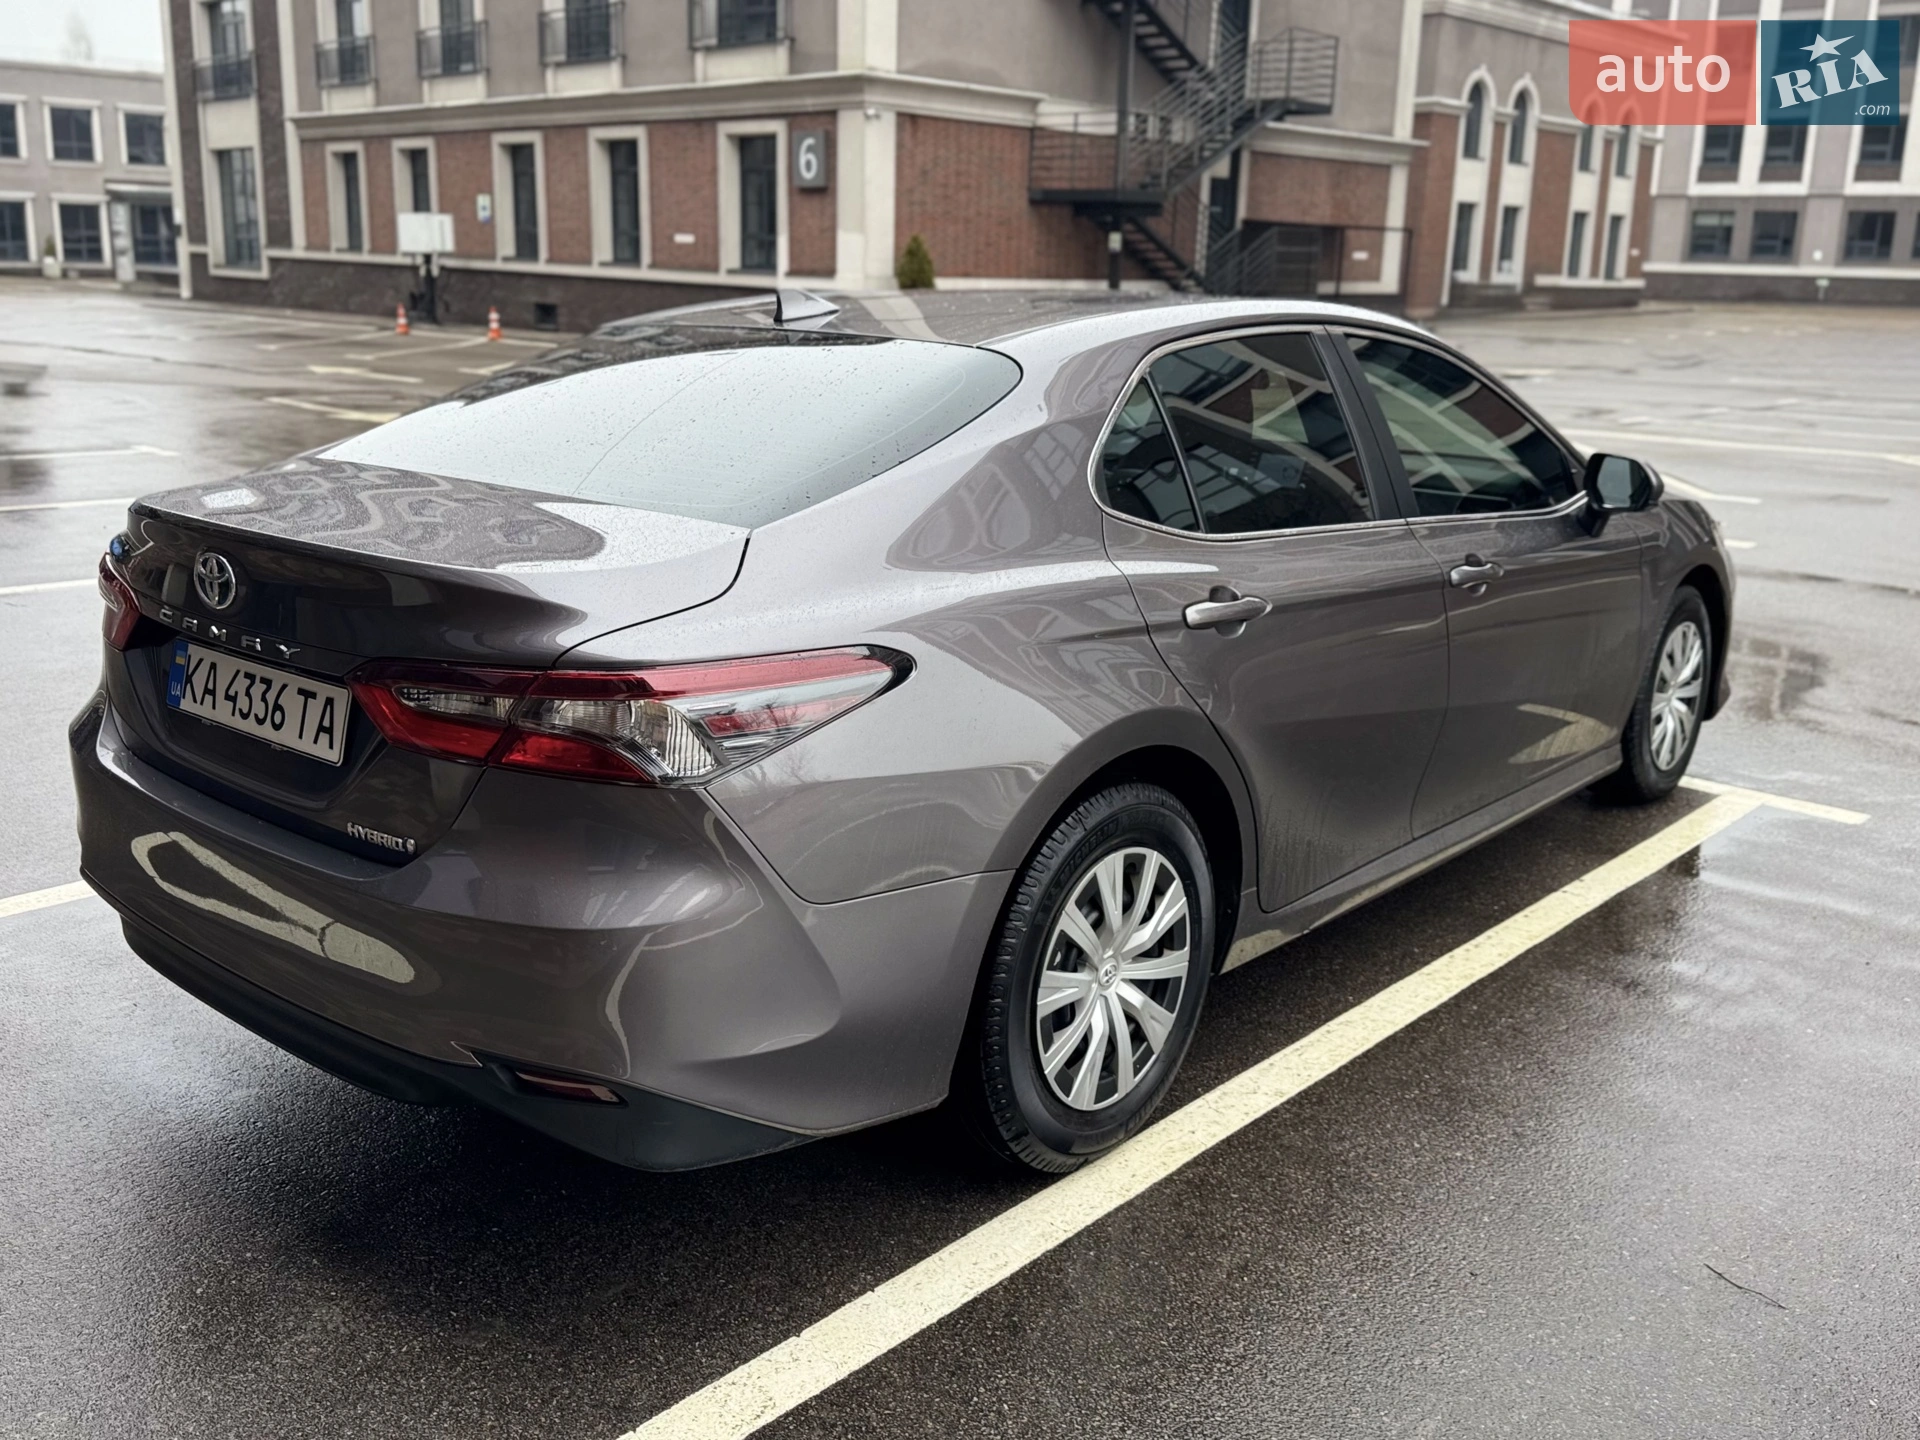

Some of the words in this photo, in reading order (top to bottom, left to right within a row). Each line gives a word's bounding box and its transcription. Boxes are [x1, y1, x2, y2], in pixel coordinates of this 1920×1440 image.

[798, 137, 818, 180] 6
[159, 606, 301, 660] CAMRY
[170, 680, 182, 698] UA
[182, 653, 218, 711] KA
[223, 668, 290, 732] 4336
[296, 686, 335, 751] TA
[346, 821, 405, 852] HYBRID
